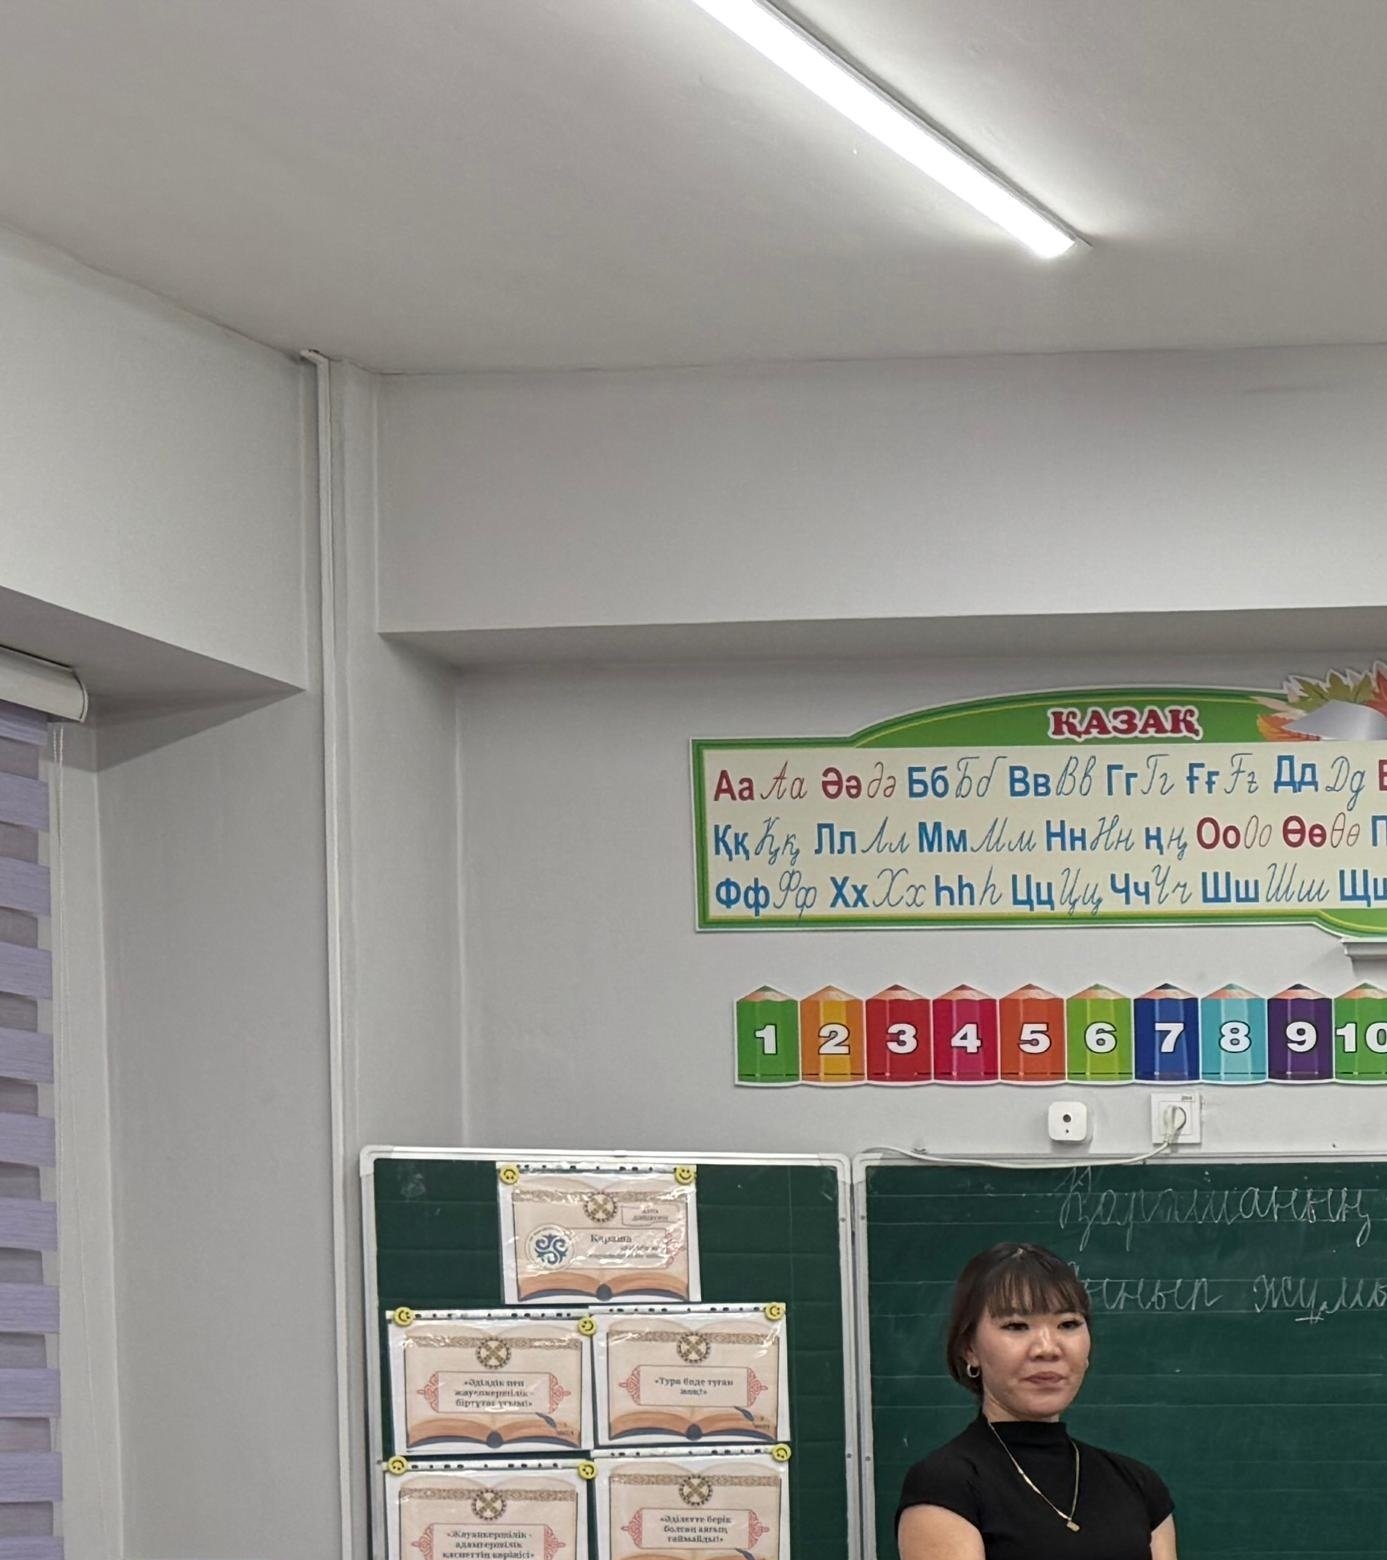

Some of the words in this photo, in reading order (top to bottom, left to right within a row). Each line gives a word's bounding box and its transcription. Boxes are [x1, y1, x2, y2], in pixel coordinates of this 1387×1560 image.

[1051, 708, 1200, 738] ҚАЗАҚ
[754, 1022, 777, 1055] 1
[818, 1022, 851, 1055] 2
[885, 1022, 918, 1055] 3
[951, 1022, 982, 1055] 4
[1018, 1022, 1051, 1055] 5
[1084, 1022, 1117, 1055] 6
[1154, 1022, 1186, 1055] 7
[1219, 1022, 1251, 1055] 8
[1285, 1022, 1317, 1055] 9
